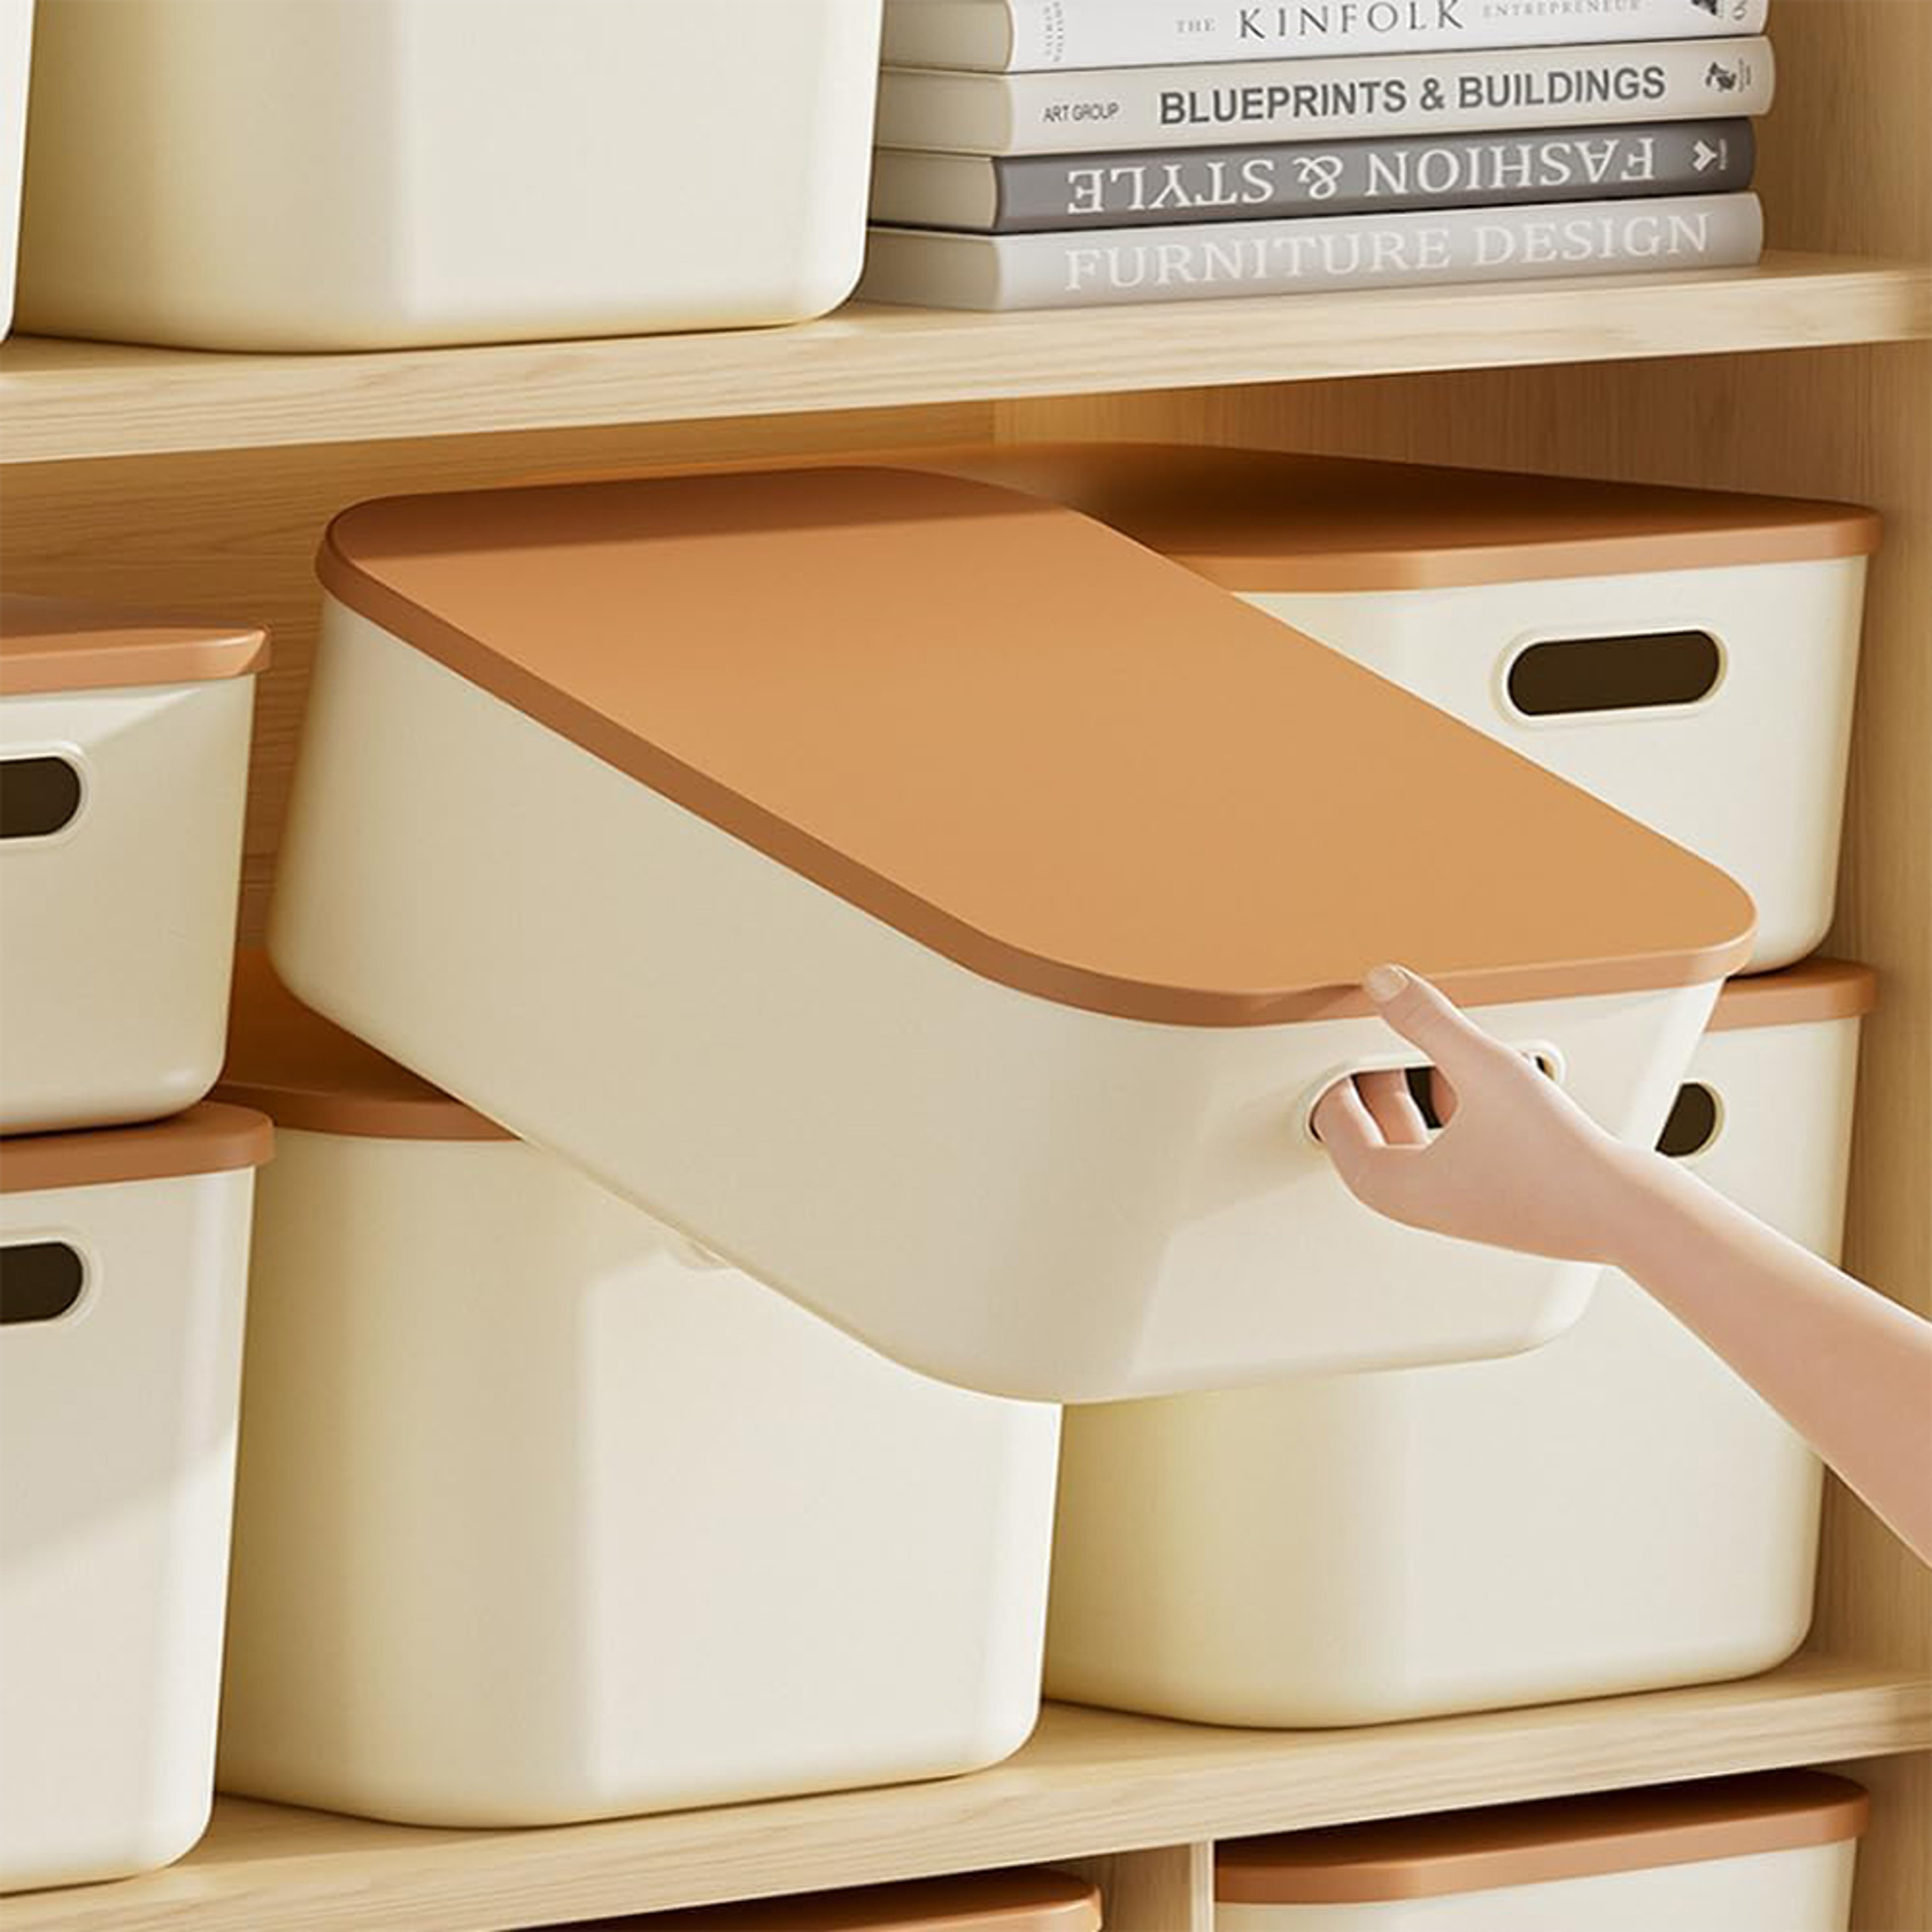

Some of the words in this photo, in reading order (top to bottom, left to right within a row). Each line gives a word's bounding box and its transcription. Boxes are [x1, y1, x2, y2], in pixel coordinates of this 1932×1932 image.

[1176, 18, 1216, 33] THE
[1240, 0, 1464, 39] KINFOLK
[1044, 105, 1071, 123] ART
[1075, 102, 1119, 121] GROUP
[1160, 81, 1407, 124] BLUEPRINTS
[1421, 78, 1444, 109] &
[1459, 66, 1666, 106] BUILDINGS
[1067, 159, 1275, 214] STYLE
[1292, 156, 1344, 200] &
[1364, 137, 1656, 197] FASHION
[1064, 231, 1451, 291] FURNITURE
[1475, 214, 1709, 266] DESIGN
